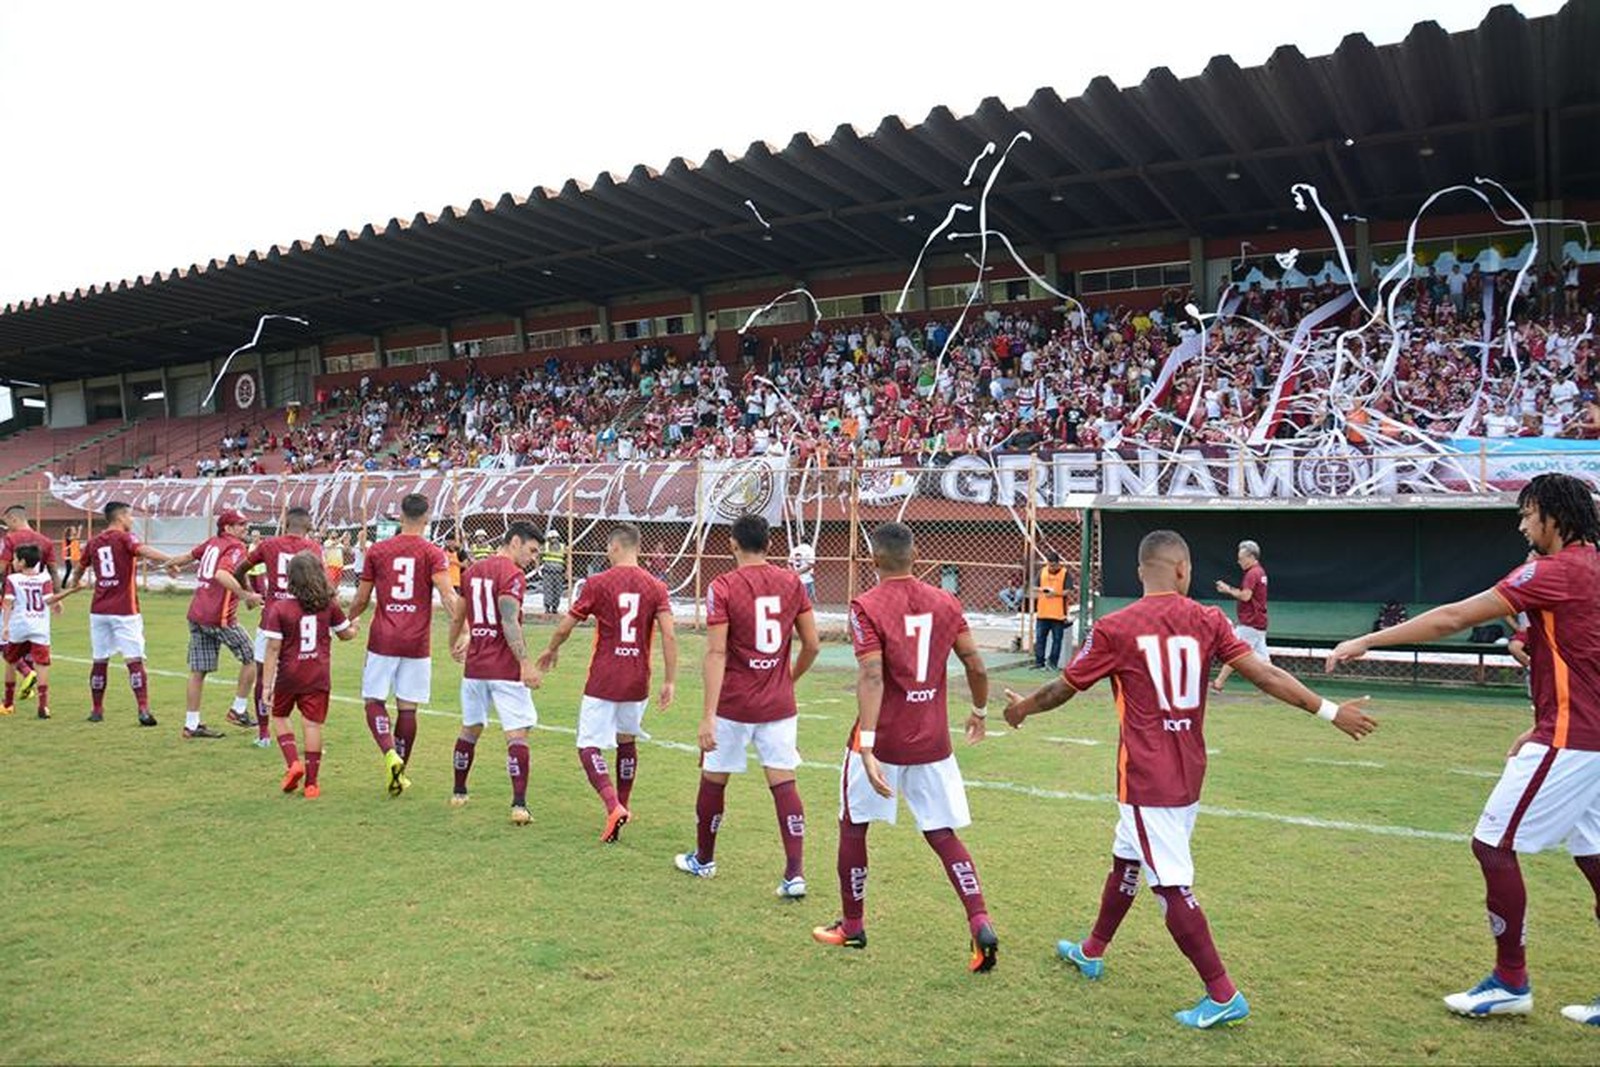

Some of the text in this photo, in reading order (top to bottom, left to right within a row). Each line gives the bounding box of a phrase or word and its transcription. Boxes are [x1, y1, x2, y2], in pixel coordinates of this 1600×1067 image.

[97, 545, 116, 578] 8
[197, 545, 220, 579] 10
[277, 552, 298, 590] 5
[391, 556, 415, 601] 3
[24, 588, 45, 612] 10
[470, 577, 497, 625] 11
[618, 592, 641, 643] 2
[299, 614, 318, 653] 9
[755, 595, 782, 654] 6
[904, 612, 933, 683] 7
[1135, 634, 1201, 712] 10
